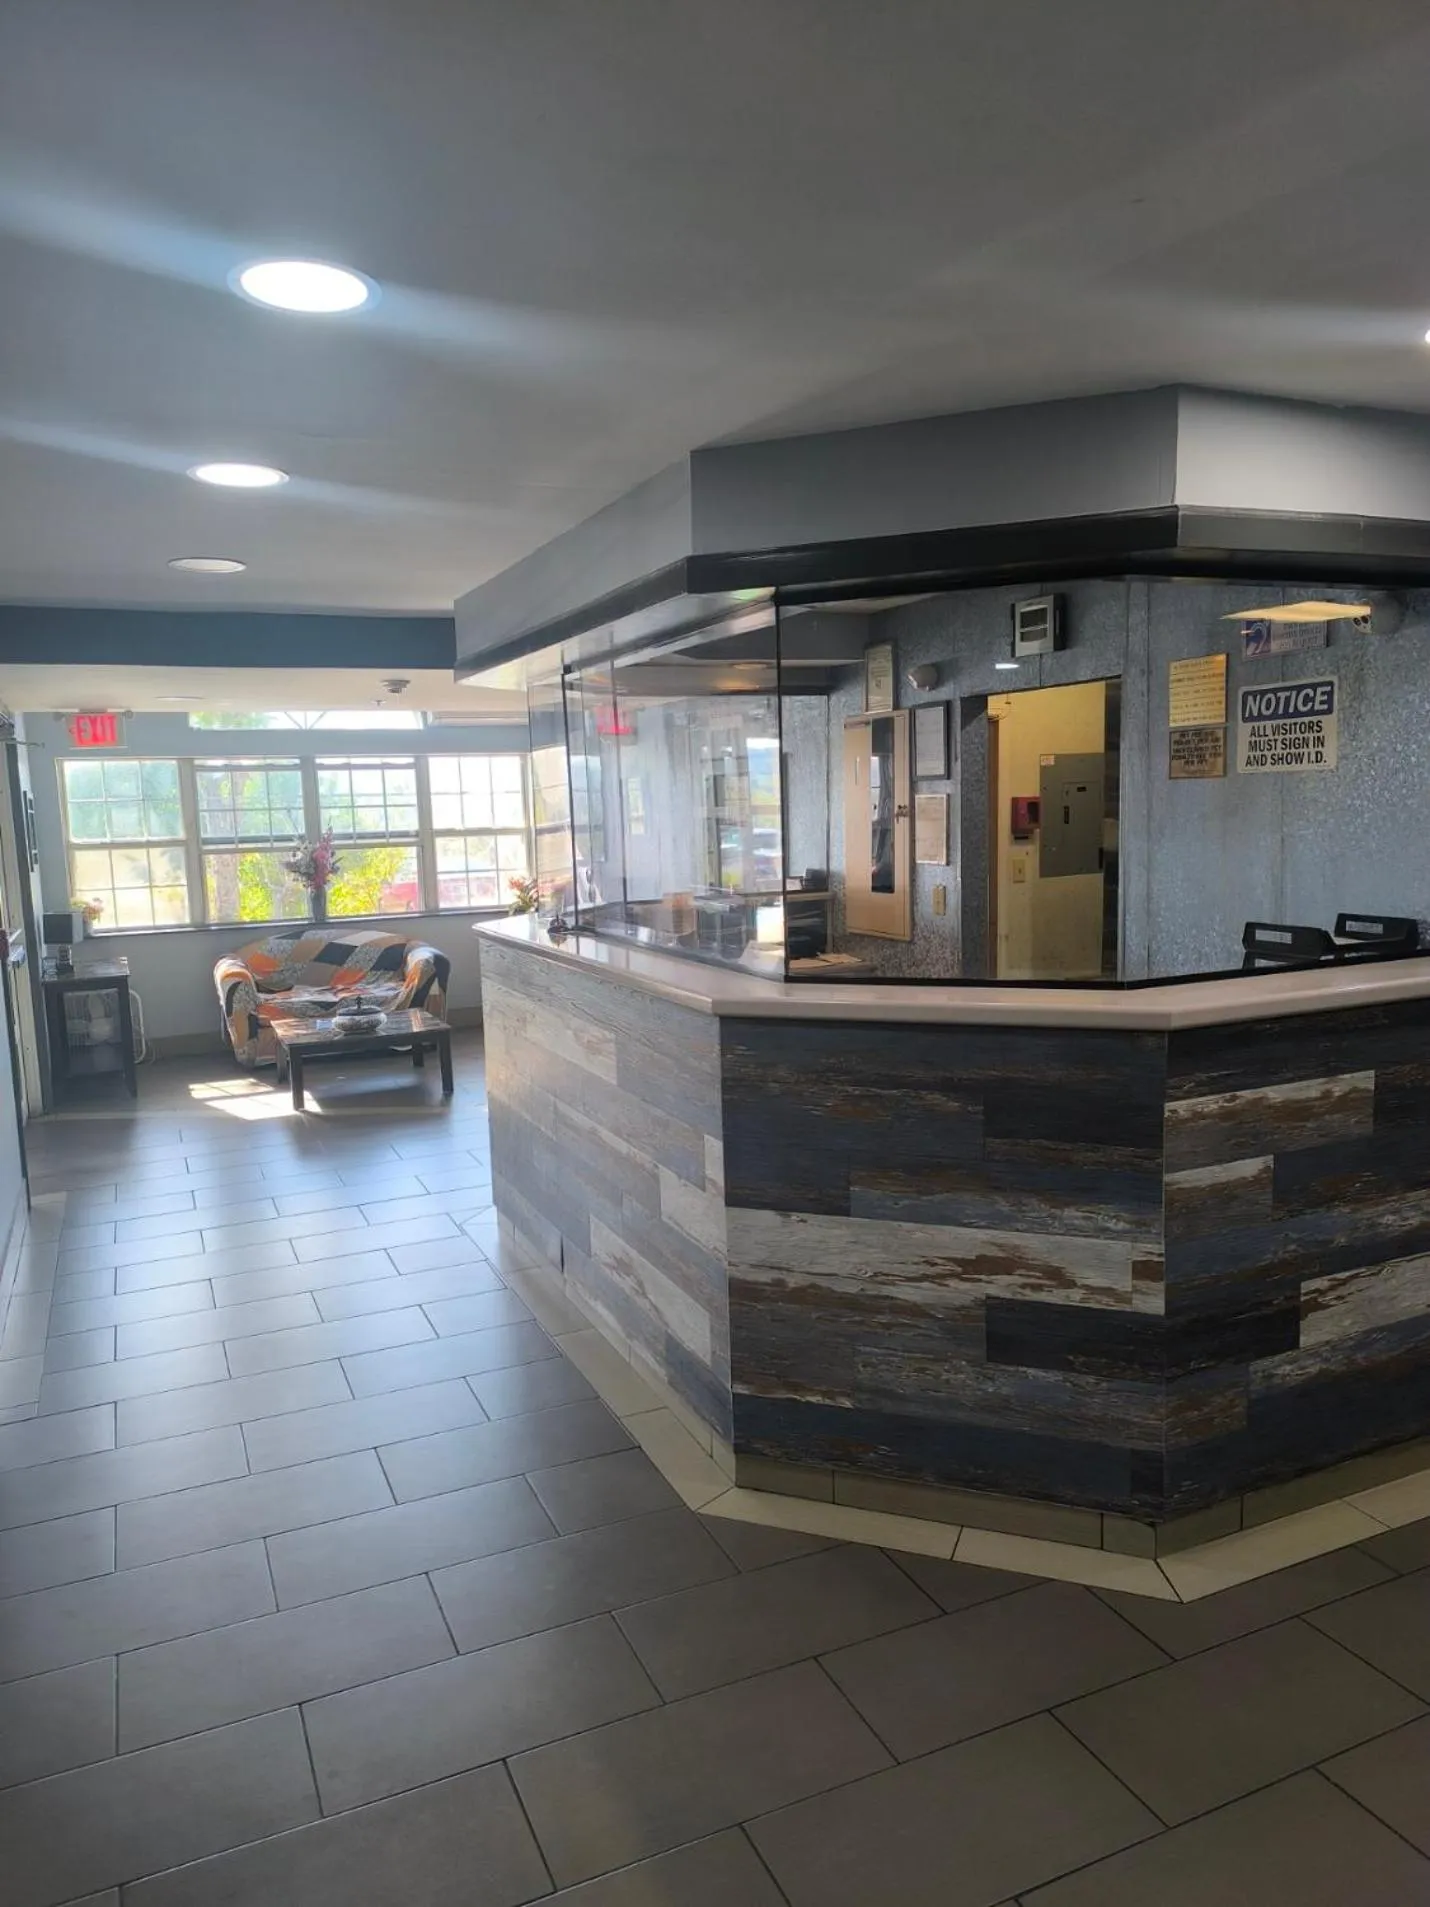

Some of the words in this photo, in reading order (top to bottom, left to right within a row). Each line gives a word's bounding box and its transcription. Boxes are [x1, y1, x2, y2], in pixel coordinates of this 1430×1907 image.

[1245, 686, 1332, 717] NOTICE
[75, 714, 115, 744] EXIT
[1249, 725, 1269, 738] ALL
[1271, 720, 1323, 737] VISITORS
[1248, 738, 1278, 752] MUST
[1280, 736, 1310, 751] SIGN
[1312, 735, 1325, 748] IN
[1245, 754, 1268, 767] AND
[1270, 751, 1304, 766] SHOW
[1307, 751, 1328, 764] I.D.
